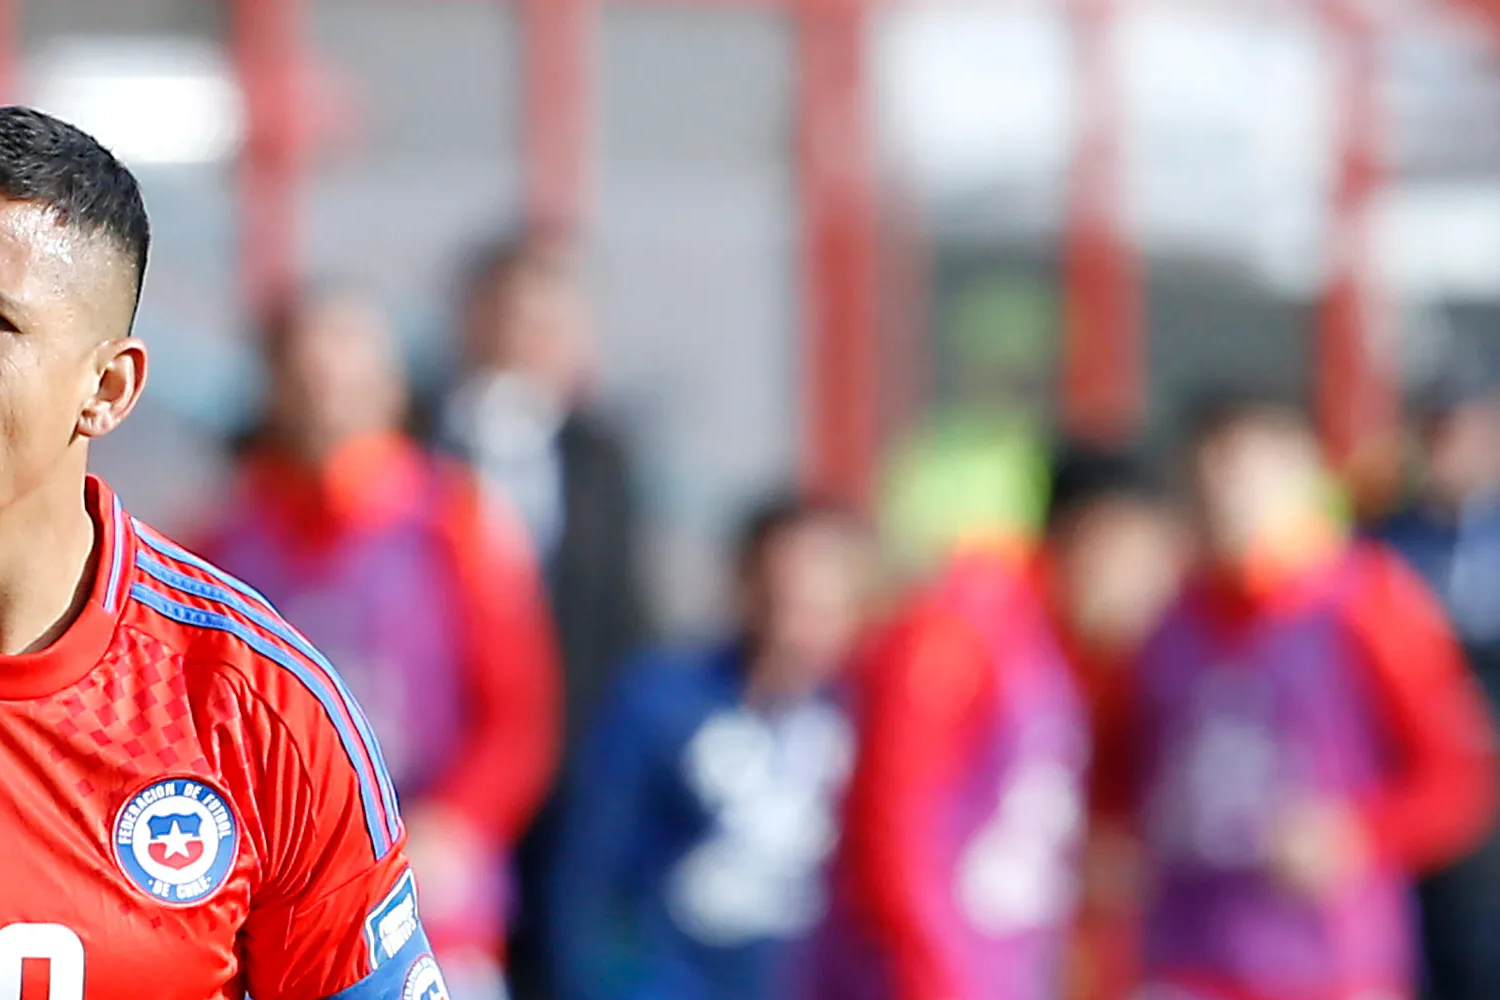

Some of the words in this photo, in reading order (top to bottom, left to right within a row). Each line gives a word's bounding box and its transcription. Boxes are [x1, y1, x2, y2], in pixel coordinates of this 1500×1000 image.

[118, 782, 175, 844] FEDERACION
[183, 783, 202, 798] DE
[203, 793, 233, 839] FUTBOL
